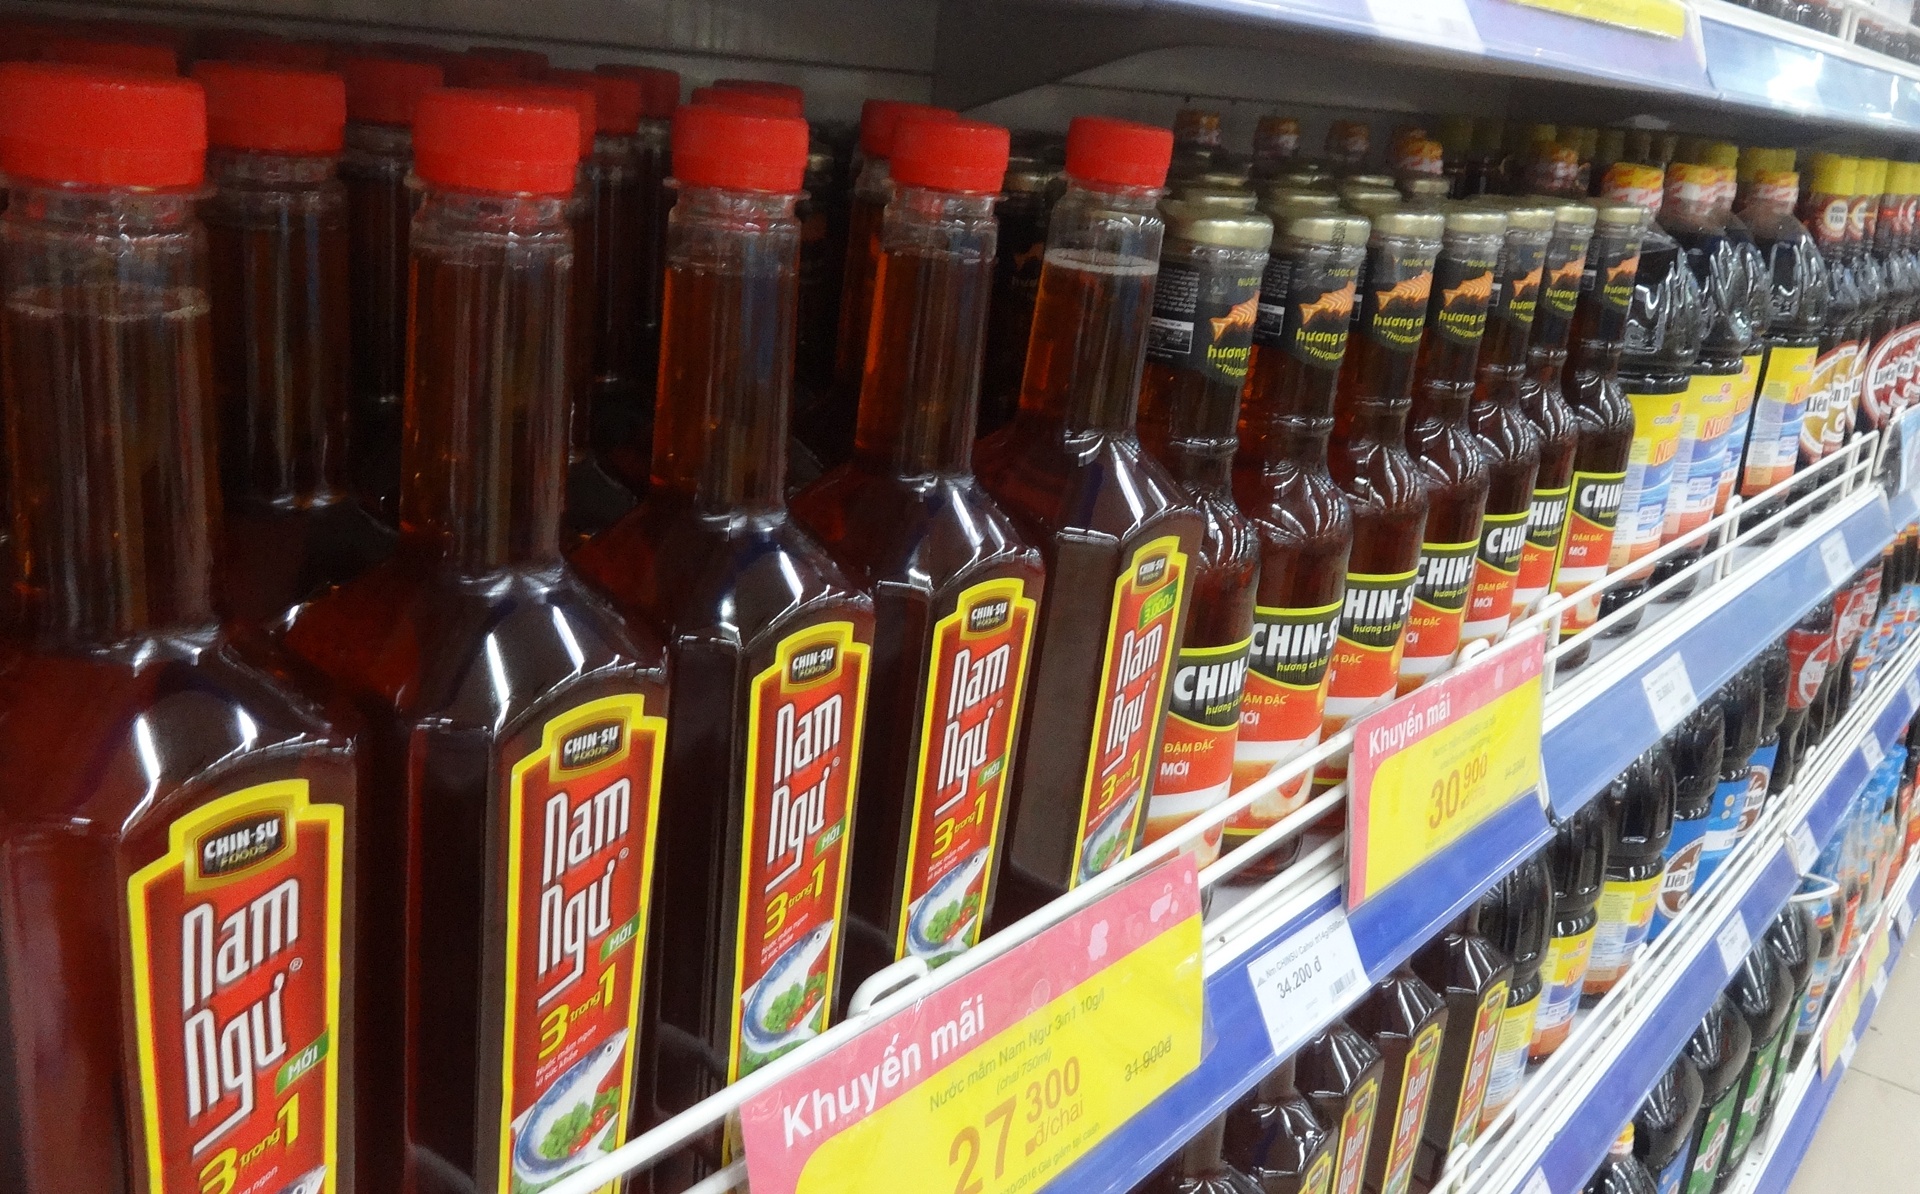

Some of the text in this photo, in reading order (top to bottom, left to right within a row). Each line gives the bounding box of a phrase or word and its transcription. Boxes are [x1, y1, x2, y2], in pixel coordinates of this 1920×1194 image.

[1296, 328, 1339, 346] hương
[1373, 314, 1413, 330] hương
[1207, 344, 1247, 361] hương
[1528, 498, 1567, 525] HIN-
[1416, 551, 1477, 584] CHIN-
[971, 601, 1008, 620] CHIN-SU
[1353, 621, 1381, 635] hương
[1250, 614, 1341, 656] CHIN-S
[792, 646, 835, 670] CHIN-SU
[1115, 623, 1163, 693] Nam
[1173, 656, 1248, 701] CHIN-
[1276, 660, 1307, 674] hương
[1340, 653, 1365, 664] ĐẶC
[947, 643, 1010, 720] Nam
[1264, 693, 1290, 707] ĐẶC
[1102, 679, 1150, 777] Ngư
[1206, 699, 1232, 715] hương
[1369, 703, 1424, 758] Khuyến
[1427, 692, 1450, 728] mãi
[563, 725, 620, 755] CHIN-SU
[773, 693, 842, 785] Nam
[1164, 736, 1216, 755] ĐẬM ĐẶC
[934, 707, 994, 817] Ngư
[1099, 773, 1117, 810] 3
[1131, 748, 1142, 779] 1
[1160, 761, 1189, 776] MỚI
[1463, 752, 1488, 789] 900
[204, 818, 280, 859] CHIN-SU
[543, 777, 631, 886] Nam
[765, 766, 831, 893] Ngư
[931, 817, 956, 860] 3
[974, 790, 987, 826] 1
[220, 843, 268, 868] FOODS
[764, 891, 789, 940] 3
[811, 858, 827, 899] 1
[183, 878, 299, 1013] Nam
[537, 858, 616, 1009] Ngư
[608, 922, 633, 952] MỚI
[1277, 955, 1323, 999] 34.200 đ
[538, 961, 617, 1060] 3 trong 1
[183, 972, 287, 1156] Ngư
[287, 1045, 319, 1081] MỚI
[783, 993, 985, 1148] Khuyến mãi
[929, 1079, 966, 1112] Nước
[967, 1059, 997, 1087] mắm
[999, 1039, 1026, 1066] Nam
[1026, 1056, 1080, 1124] 300
[199, 1092, 299, 1194] 3 trong 1
